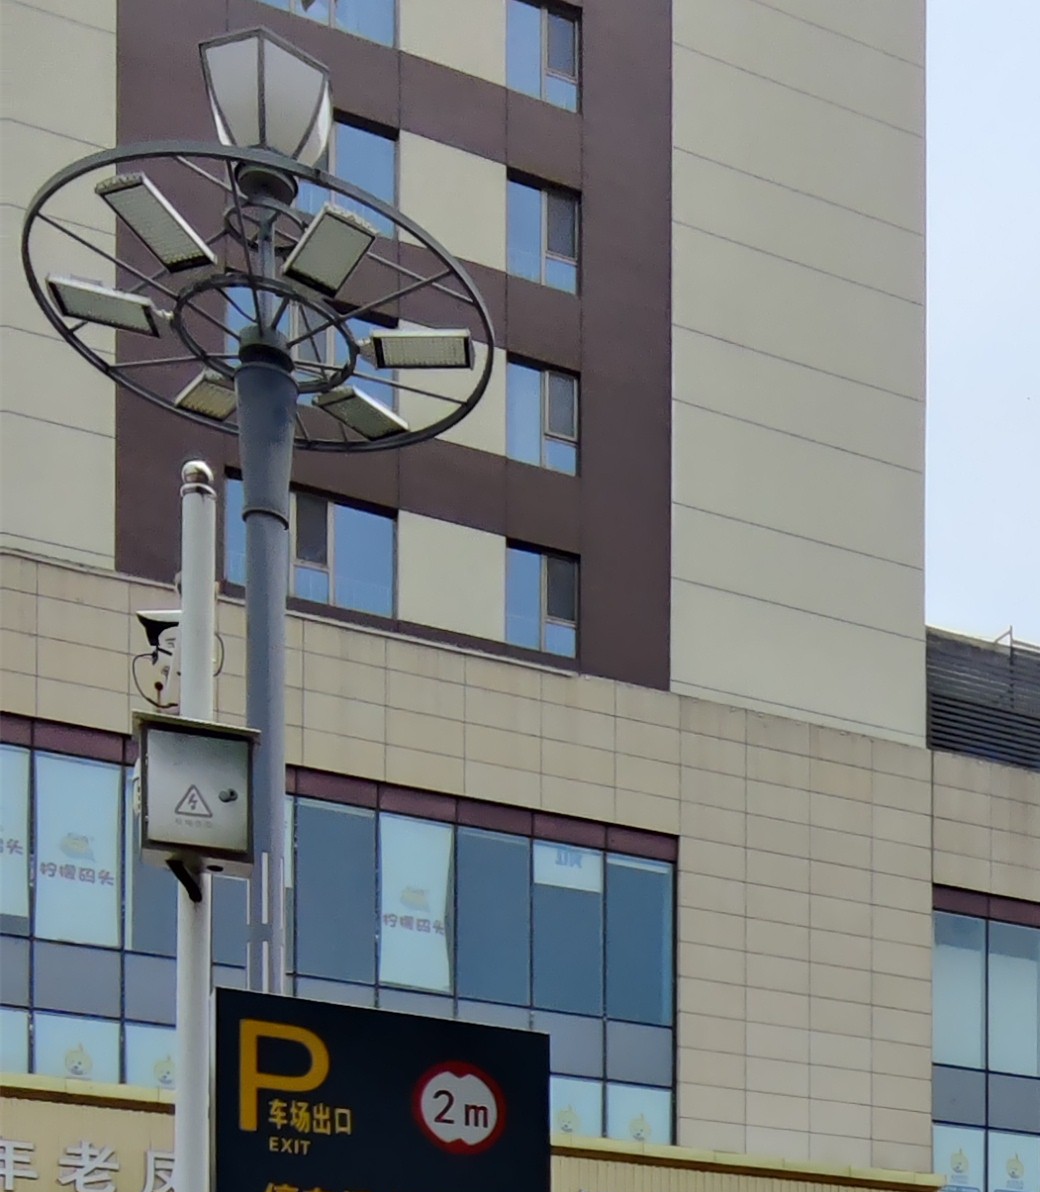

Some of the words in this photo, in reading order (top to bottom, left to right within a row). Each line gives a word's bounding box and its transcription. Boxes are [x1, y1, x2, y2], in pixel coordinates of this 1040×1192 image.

[238, 1018, 330, 1132] P
[267, 1098, 353, 1136] 车场出口
[268, 1136, 311, 1156] EXIT
